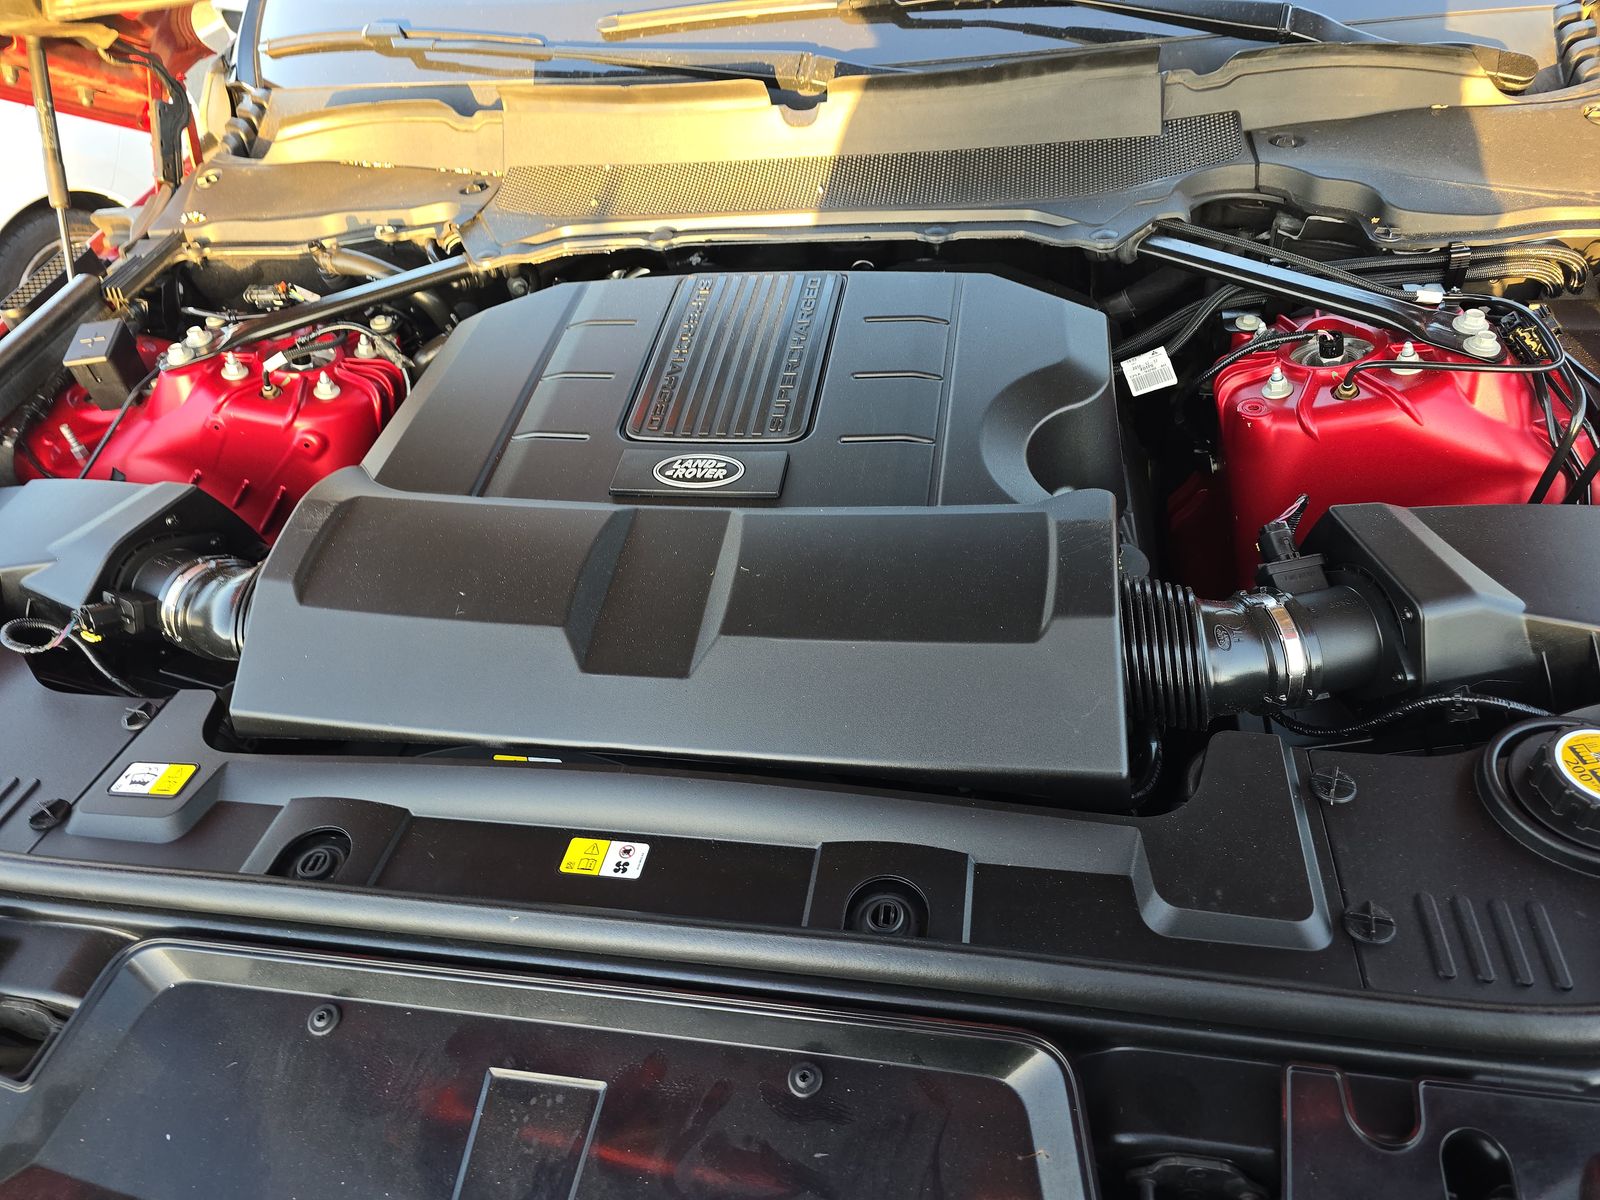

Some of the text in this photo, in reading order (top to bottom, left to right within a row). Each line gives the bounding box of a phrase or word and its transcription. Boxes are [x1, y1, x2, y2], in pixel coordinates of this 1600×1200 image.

[768, 275, 823, 433] SUPERCHARGED
[672, 459, 720, 469] LAND
[672, 468, 727, 479] ROVER
[1564, 758, 1593, 783] 200
